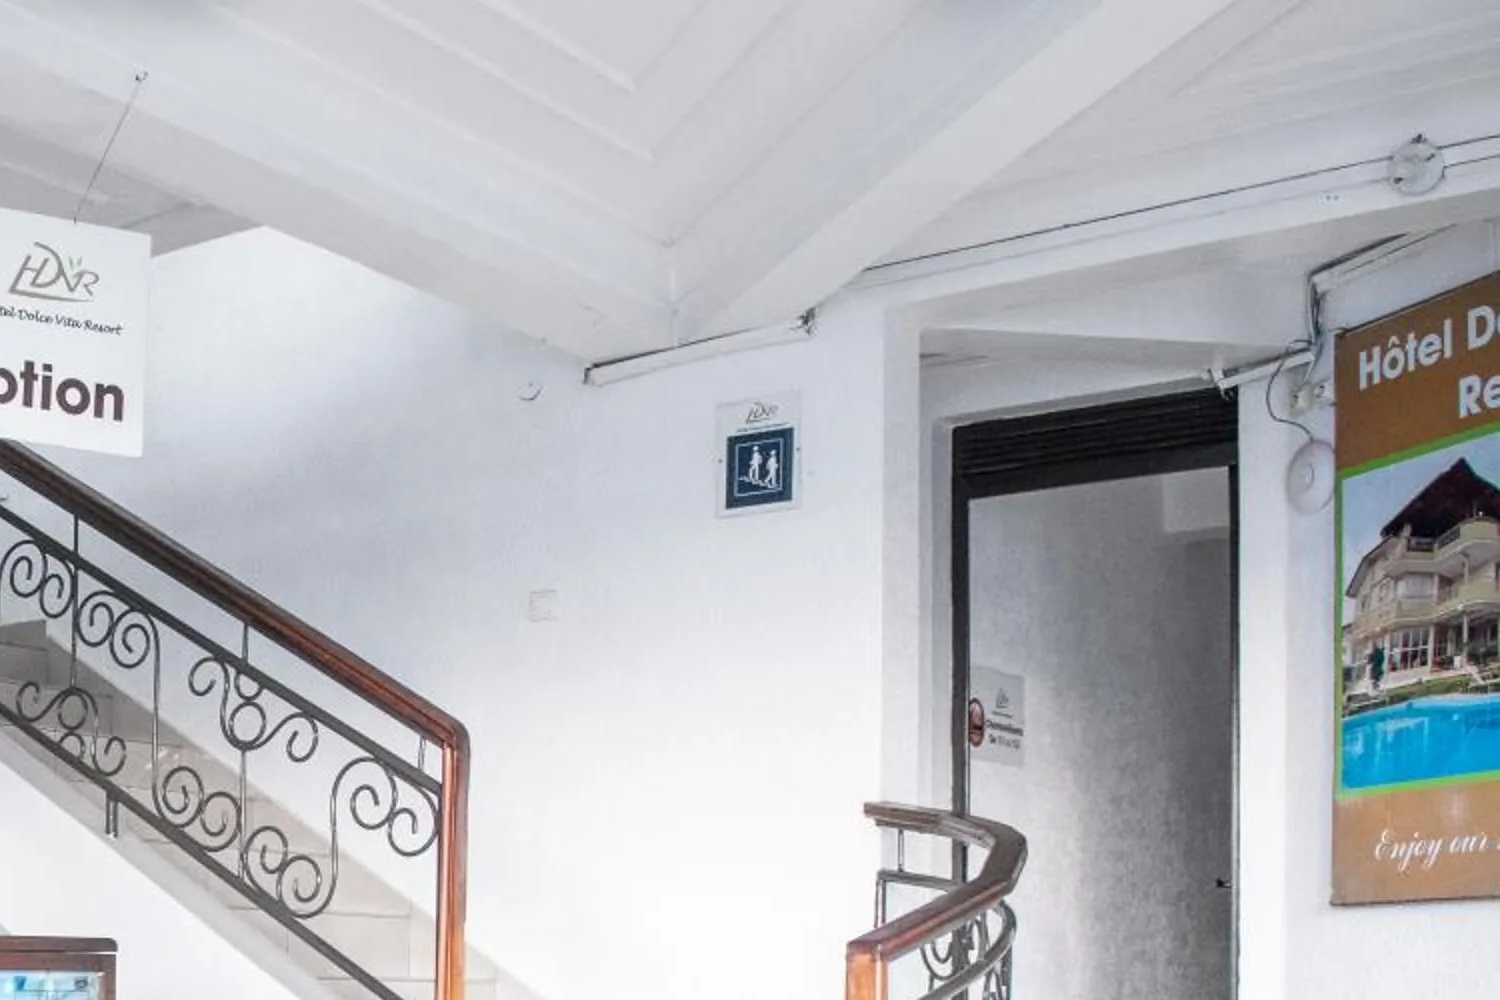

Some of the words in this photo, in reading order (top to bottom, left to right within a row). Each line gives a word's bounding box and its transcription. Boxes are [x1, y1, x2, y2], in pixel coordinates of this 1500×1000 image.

[18, 309, 53, 324] Dolce
[54, 314, 81, 329] Vita
[83, 319, 123, 336] Resort
[1359, 318, 1453, 391] Hôtel
[1467, 304, 1500, 351] D
[1375, 829, 1443, 872] Enjoy
[1449, 834, 1487, 853] our
